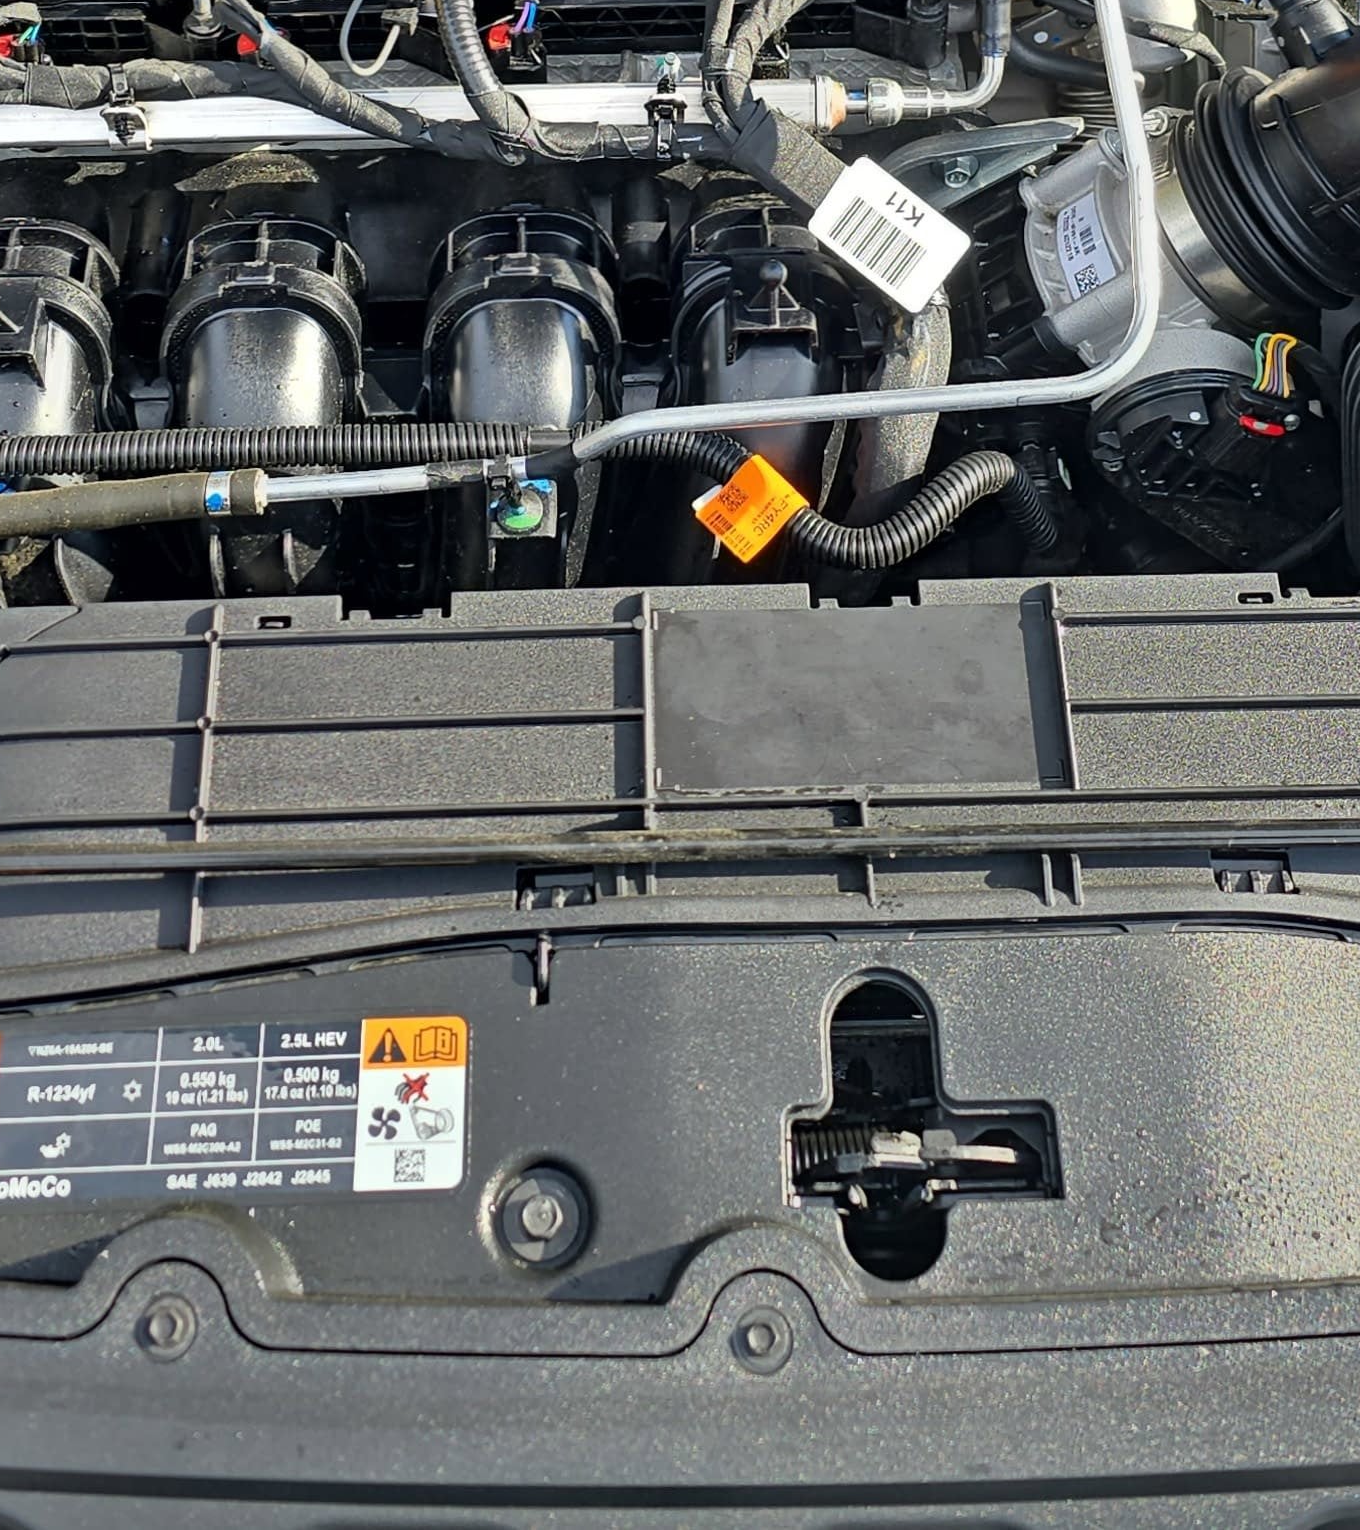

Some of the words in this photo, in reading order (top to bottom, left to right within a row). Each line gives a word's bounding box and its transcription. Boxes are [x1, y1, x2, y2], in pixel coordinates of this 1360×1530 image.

[886, 190, 925, 228] K11
[193, 1036, 225, 1053] 2.0L
[280, 1032, 312, 1049] 2.5L
[315, 1031, 348, 1047] HEV
[218, 1071, 236, 1090] kg
[283, 1066, 320, 1083] 0.500
[322, 1066, 341, 1084] kg
[27, 1083, 97, 1105] R-1234yf
[196, 1089, 223, 1107] (1.21
[226, 1088, 249, 1105] lbs)
[305, 1084, 334, 1102] (1.10
[336, 1082, 357, 1099] lbs)
[190, 1123, 217, 1138] PAG
[295, 1118, 322, 1134] POE
[166, 1174, 198, 1190] SAE
